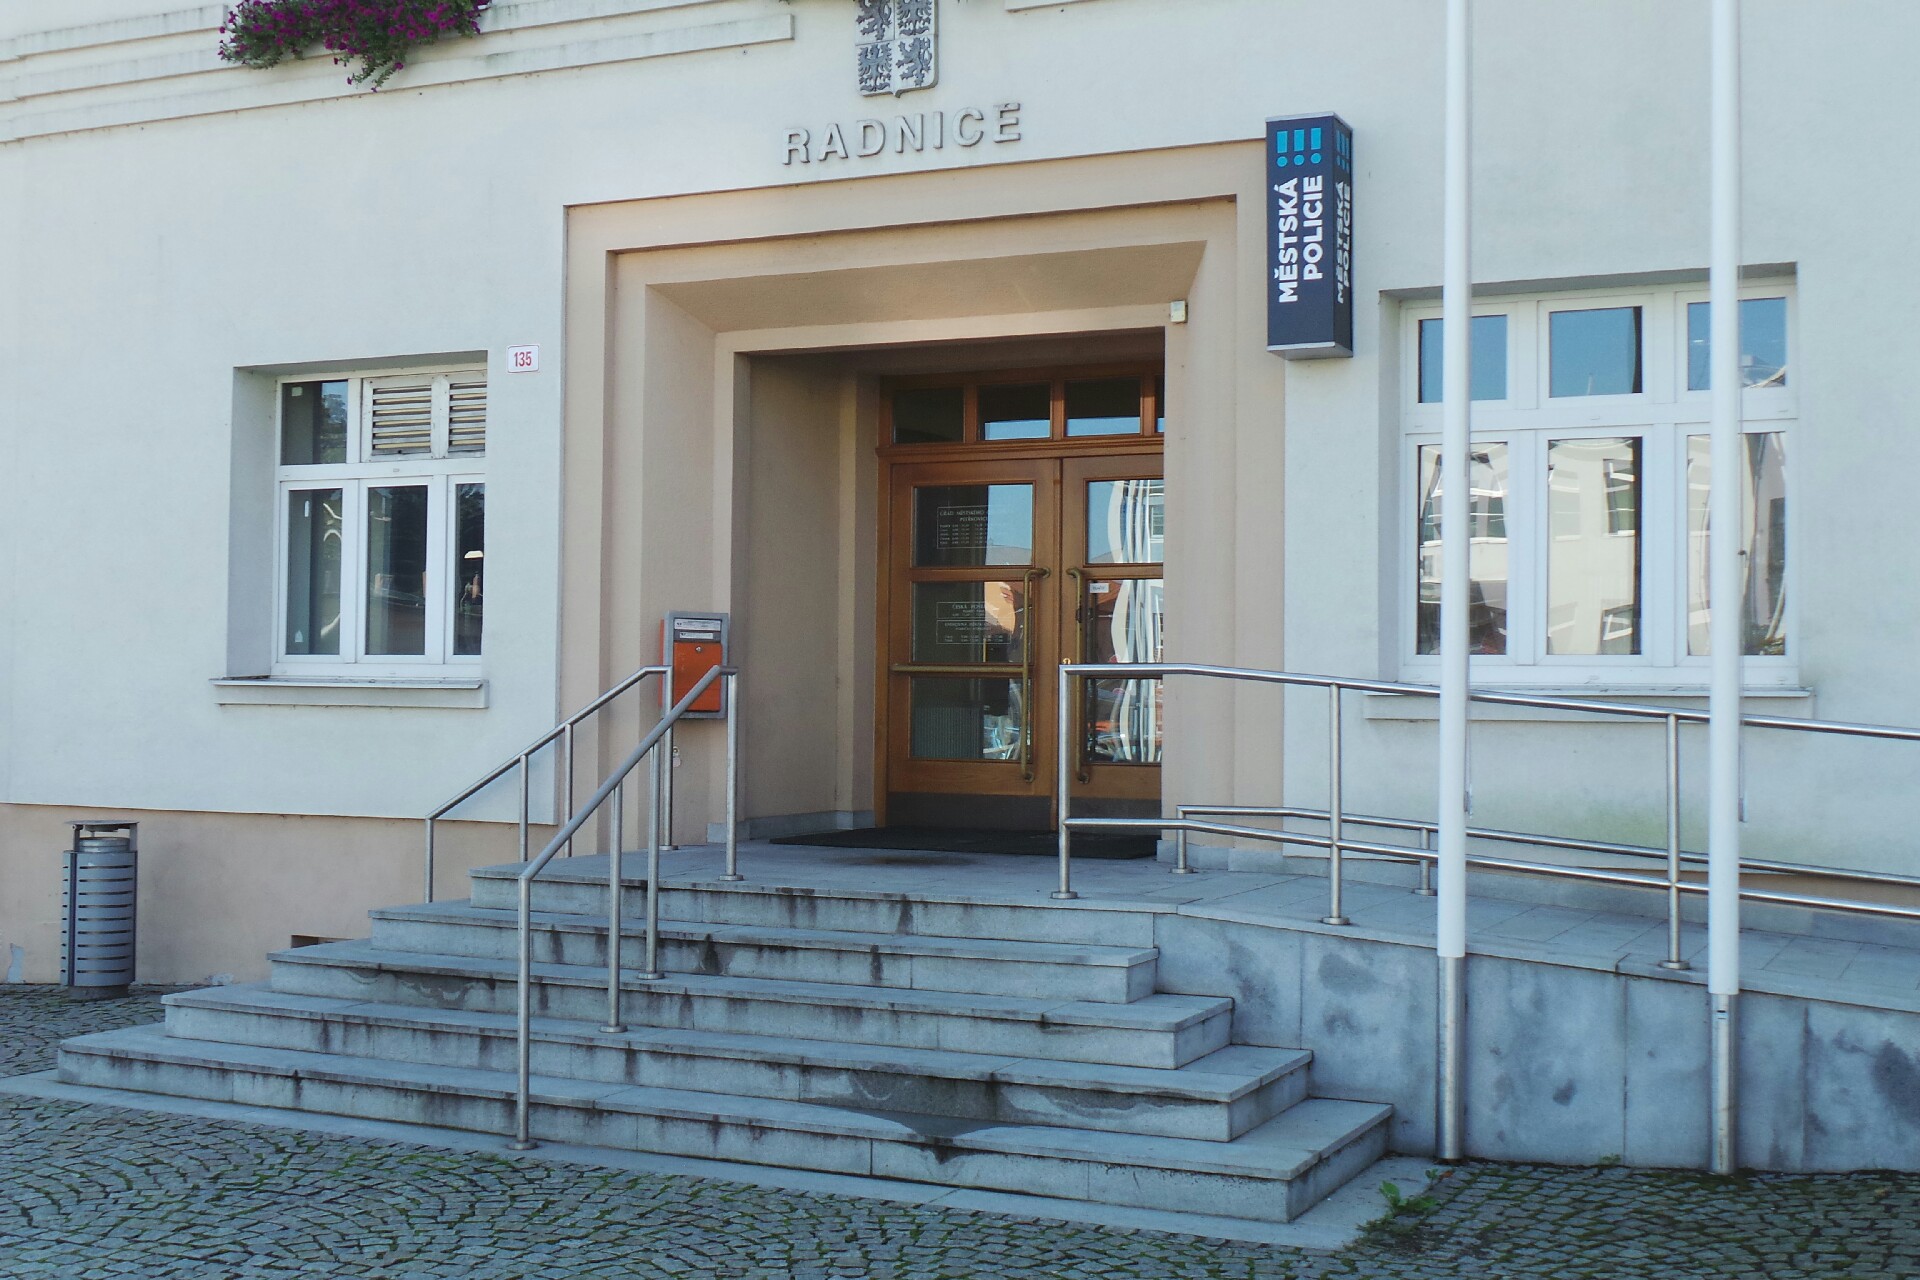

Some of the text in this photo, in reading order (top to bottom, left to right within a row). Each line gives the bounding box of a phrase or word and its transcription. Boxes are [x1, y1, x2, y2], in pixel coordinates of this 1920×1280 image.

[782, 102, 1021, 165] RADNICE
[1273, 177, 1299, 303] MĚSTSKÁ
[1303, 175, 1324, 281] POLICIE
[1343, 183, 1351, 288] POLICIE
[514, 351, 532, 367] 135
